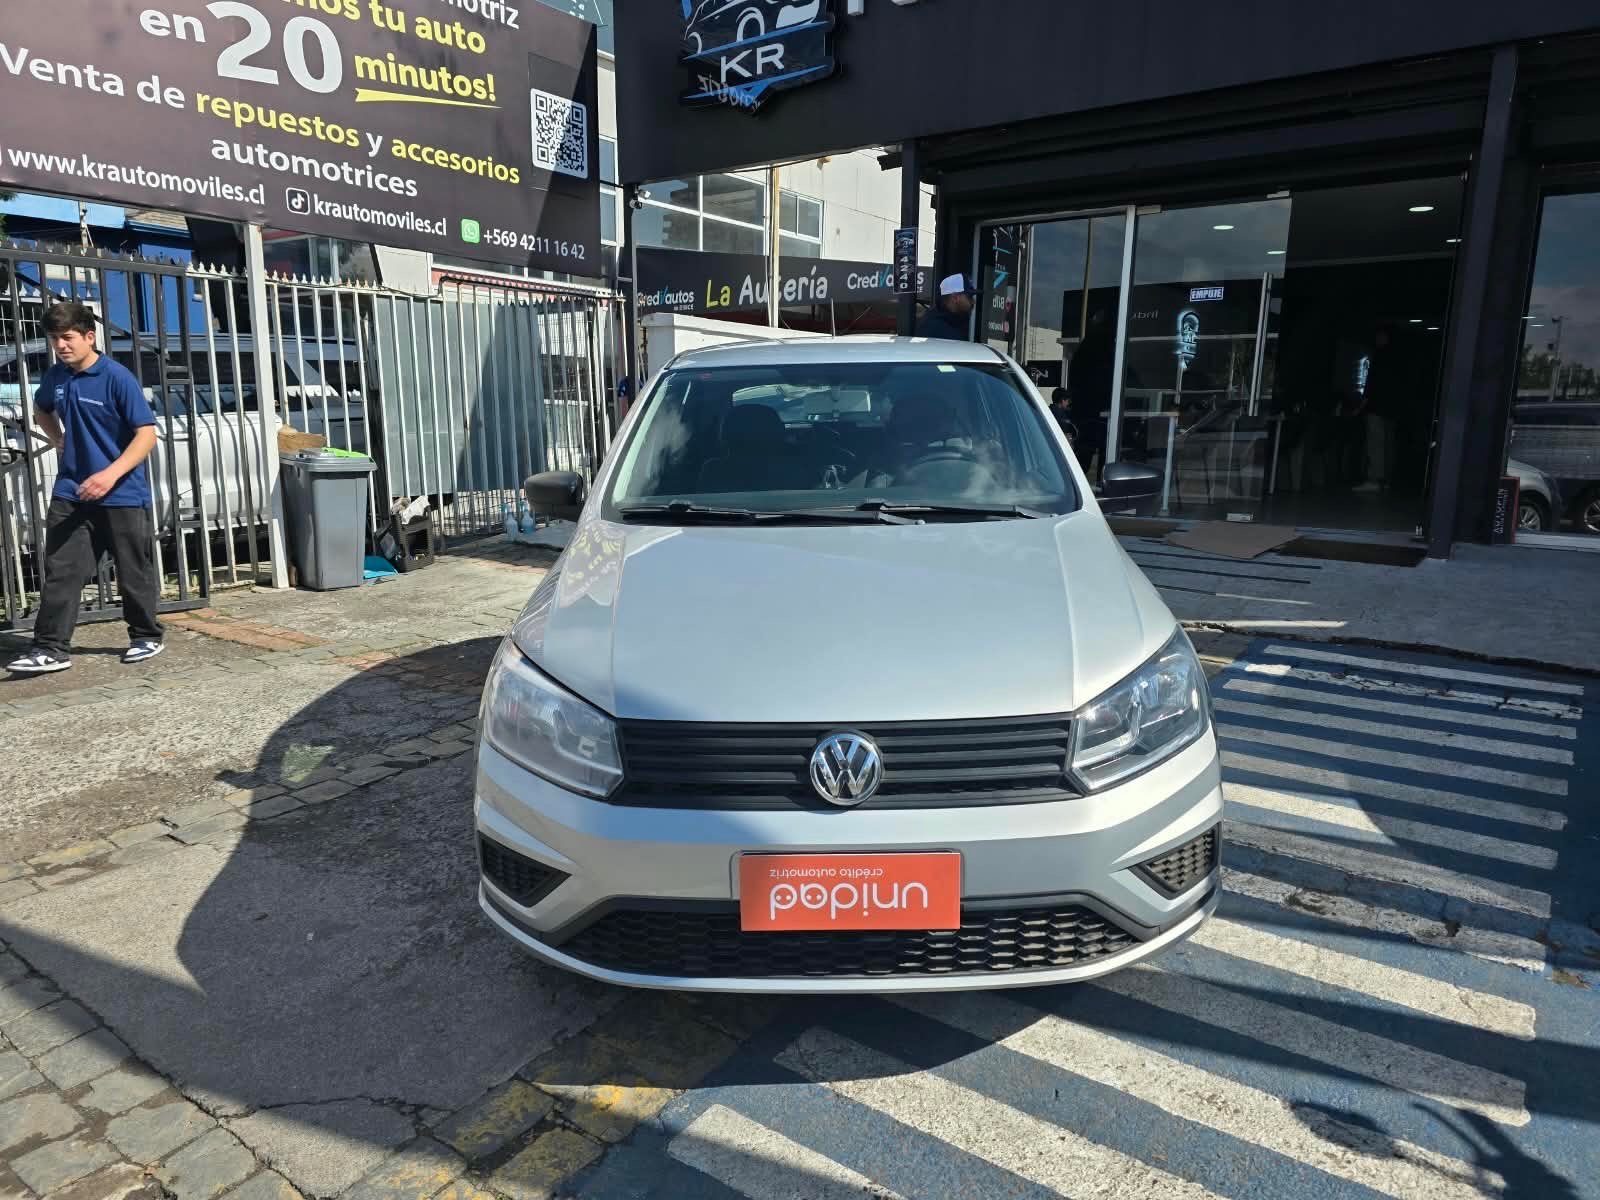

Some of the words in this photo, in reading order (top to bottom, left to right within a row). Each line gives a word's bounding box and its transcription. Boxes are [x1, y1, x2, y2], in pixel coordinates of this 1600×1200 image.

[139, 9, 206, 42] en
[206, 1, 343, 93] 20
[369, 0, 406, 33] tu
[415, 16, 486, 54] auto
[354, 52, 496, 101] minutos!
[720, 43, 785, 83] KR
[0, 43, 124, 96] Venta
[137, 76, 185, 108] de
[197, 92, 360, 147] repuestos
[366, 132, 383, 157] y
[391, 139, 520, 184] accesorios
[8, 148, 265, 205] www.krautomoviles.cl
[211, 139, 418, 197] automotrices
[314, 194, 447, 236] krautomoviles.cl
[484, 228, 517, 248] +569
[520, 233, 549, 254] 4211
[554, 240, 568, 256] 16
[571, 243, 585, 260] 42
[706, 280, 731, 308] La
[739, 265, 828, 305] Auería
[1191, 288, 1222, 300] EMPUJE
[770, 868, 837, 879] automotriz
[839, 868, 883, 879] crédito
[770, 882, 928, 921] unidad
